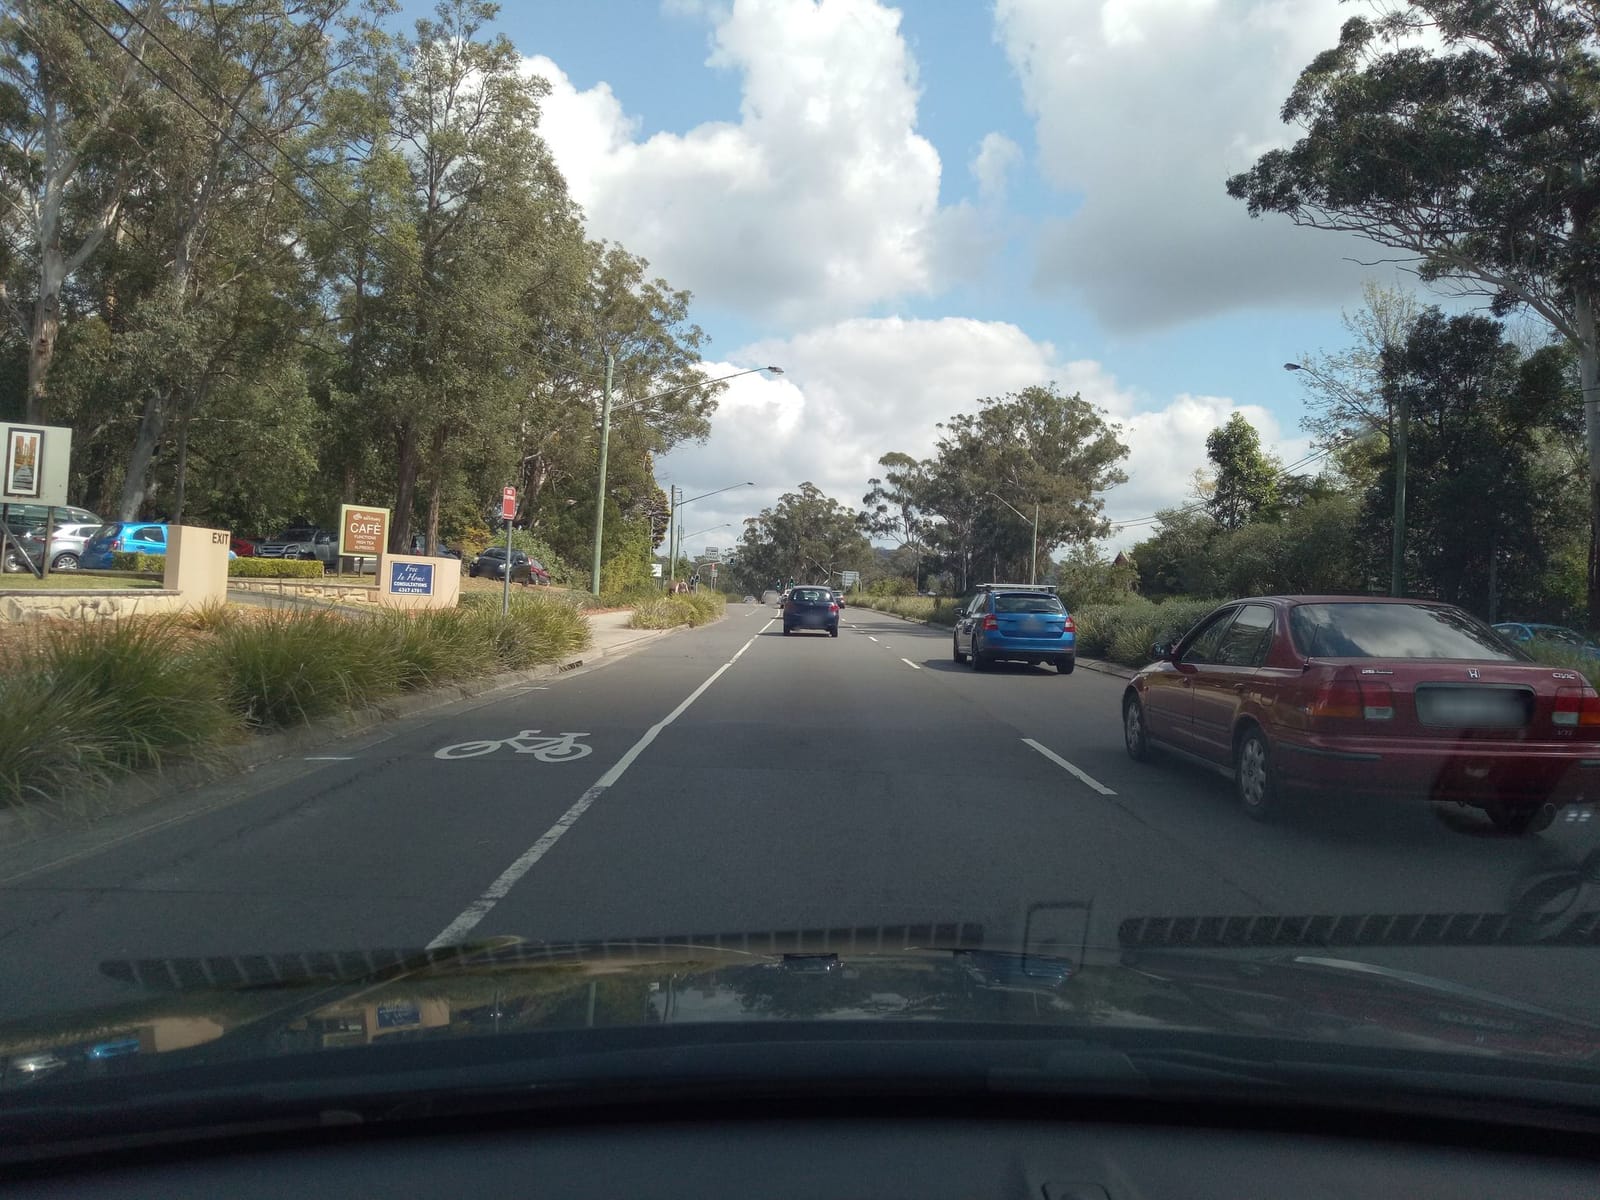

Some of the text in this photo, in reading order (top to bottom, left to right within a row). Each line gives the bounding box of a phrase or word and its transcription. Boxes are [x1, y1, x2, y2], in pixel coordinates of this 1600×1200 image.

[212, 532, 229, 544] EXIT
[405, 564, 418, 572] Free
[406, 573, 425, 582] Home
[1552, 672, 1576, 680] CIVIC
